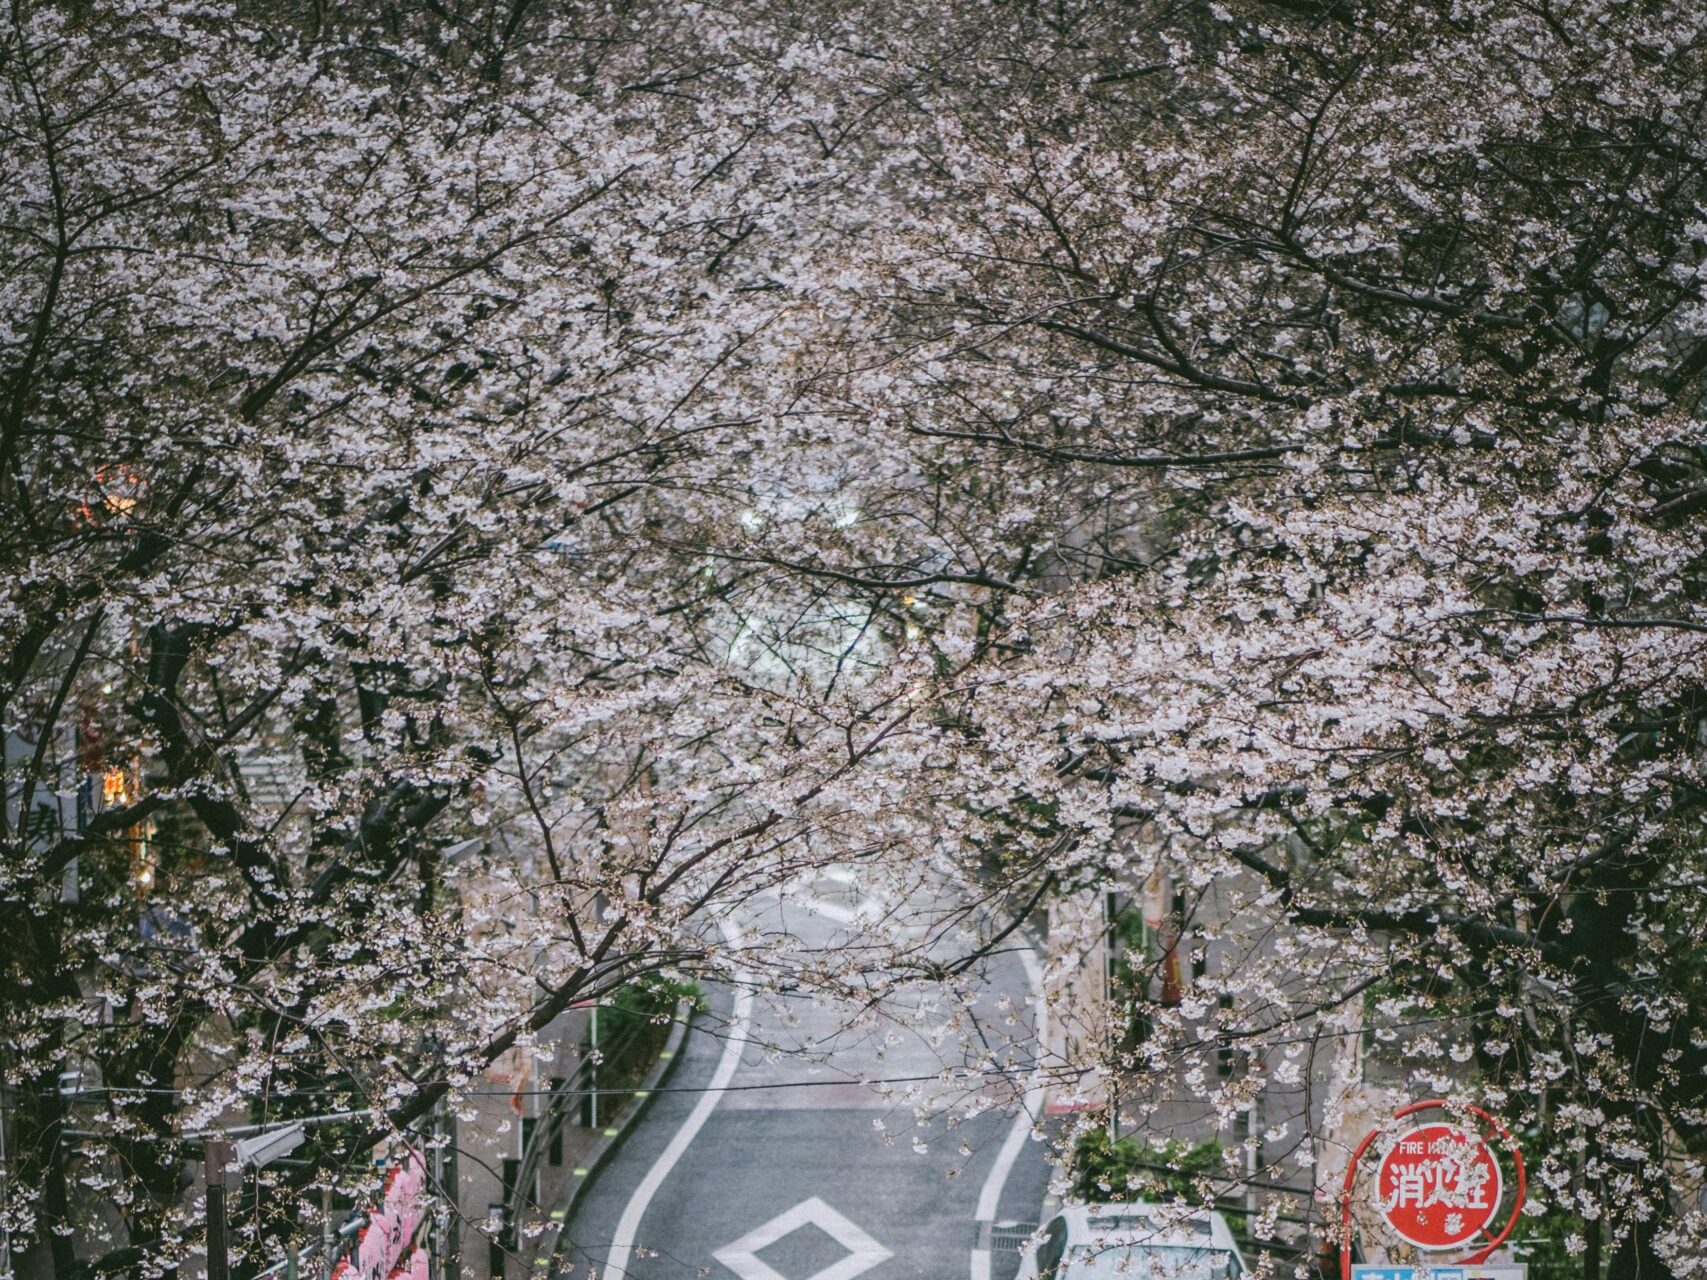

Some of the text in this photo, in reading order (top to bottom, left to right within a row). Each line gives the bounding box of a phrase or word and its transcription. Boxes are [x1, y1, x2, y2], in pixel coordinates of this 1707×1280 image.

[1400, 1142, 1423, 1155] FIRE
[1388, 1160, 1490, 1209] 消火栓
